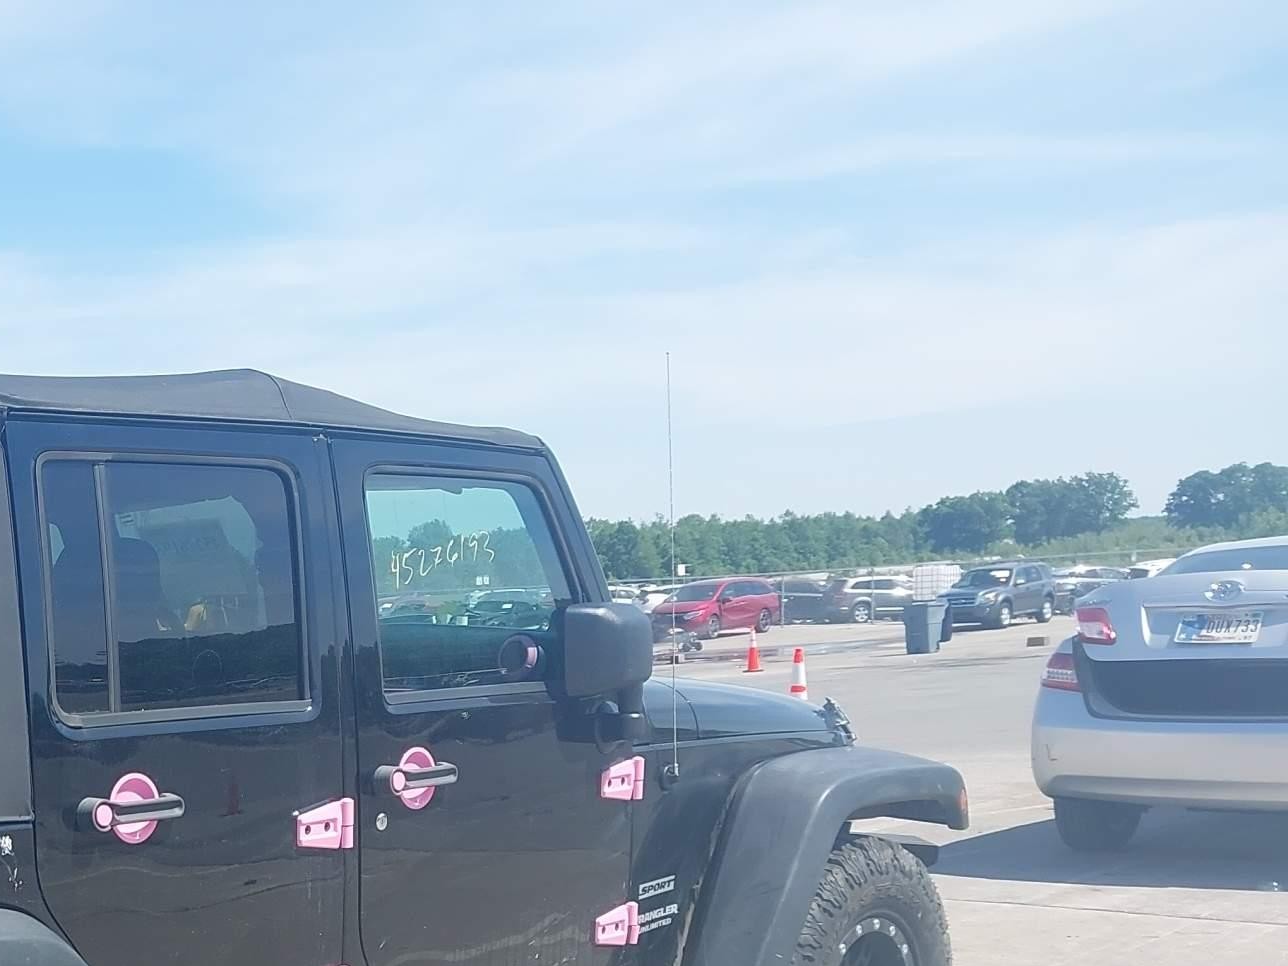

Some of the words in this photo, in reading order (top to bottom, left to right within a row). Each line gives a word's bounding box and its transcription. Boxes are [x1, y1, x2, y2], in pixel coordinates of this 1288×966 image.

[391, 530, 495, 589] 45276193
[1207, 619, 1260, 633] DUX733
[639, 879, 674, 897] SPORT
[638, 904, 678, 924] RANGLER
